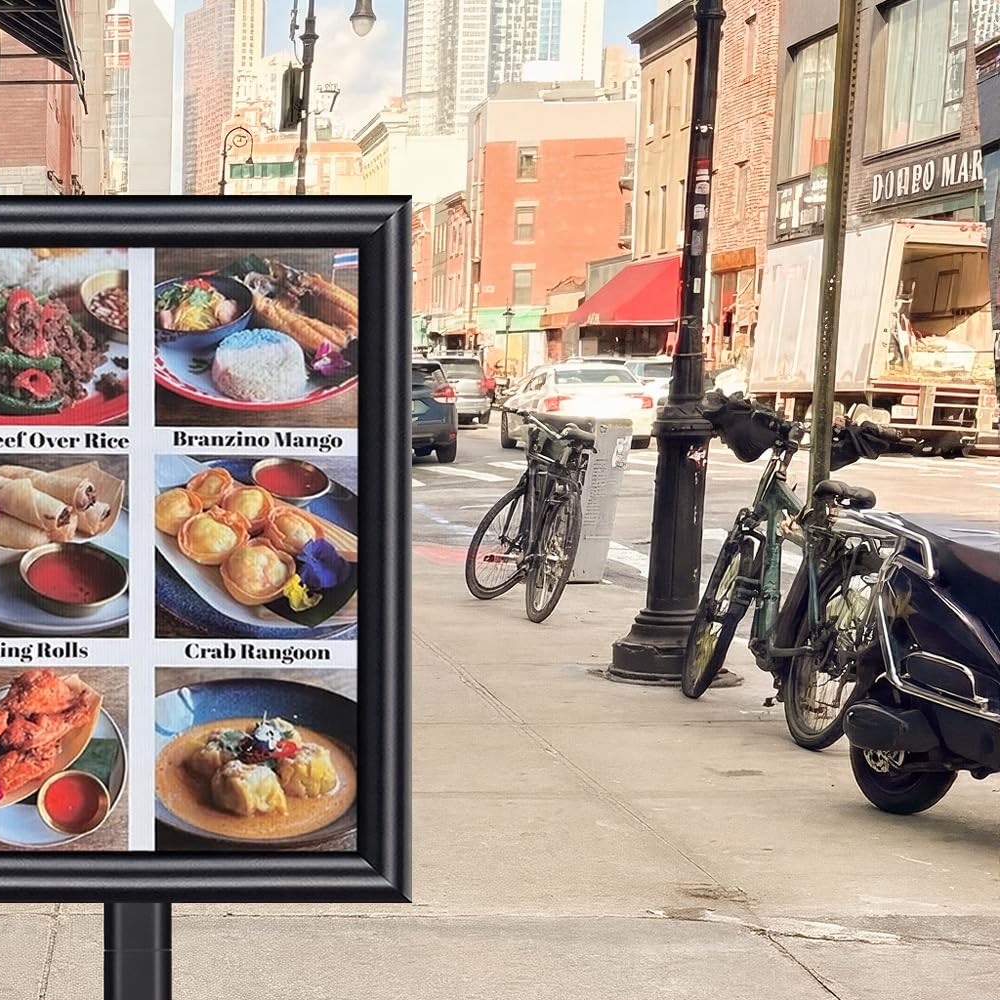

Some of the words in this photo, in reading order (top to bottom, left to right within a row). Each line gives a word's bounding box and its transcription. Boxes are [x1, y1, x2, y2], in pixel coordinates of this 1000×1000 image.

[29, 431, 81, 449] Over
[84, 432, 130, 449] Rice
[173, 431, 270, 448] Branzino
[274, 431, 343, 453] Mango
[37, 641, 89, 658] Rolls
[184, 642, 236, 659] Crab
[241, 643, 331, 665] Rangoon
